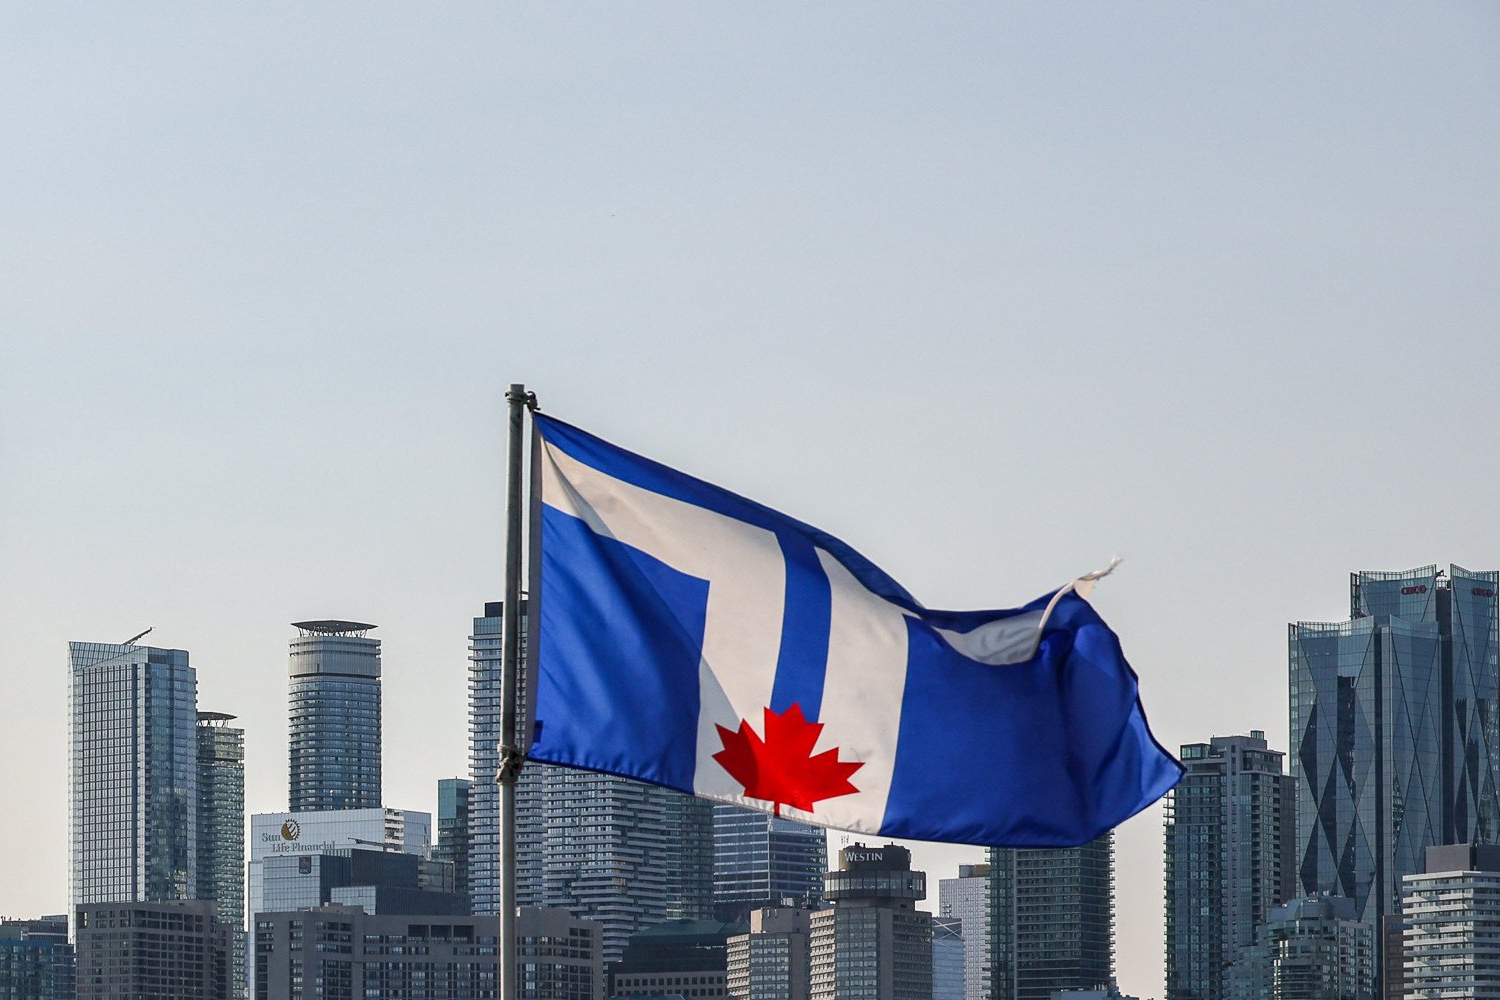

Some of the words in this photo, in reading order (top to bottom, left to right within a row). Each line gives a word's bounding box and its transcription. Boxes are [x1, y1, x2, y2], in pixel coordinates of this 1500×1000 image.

[262, 833, 281, 842] Sun
[272, 843, 290, 852] Life
[292, 840, 335, 852] Financial
[845, 852, 883, 862] WESTIN
